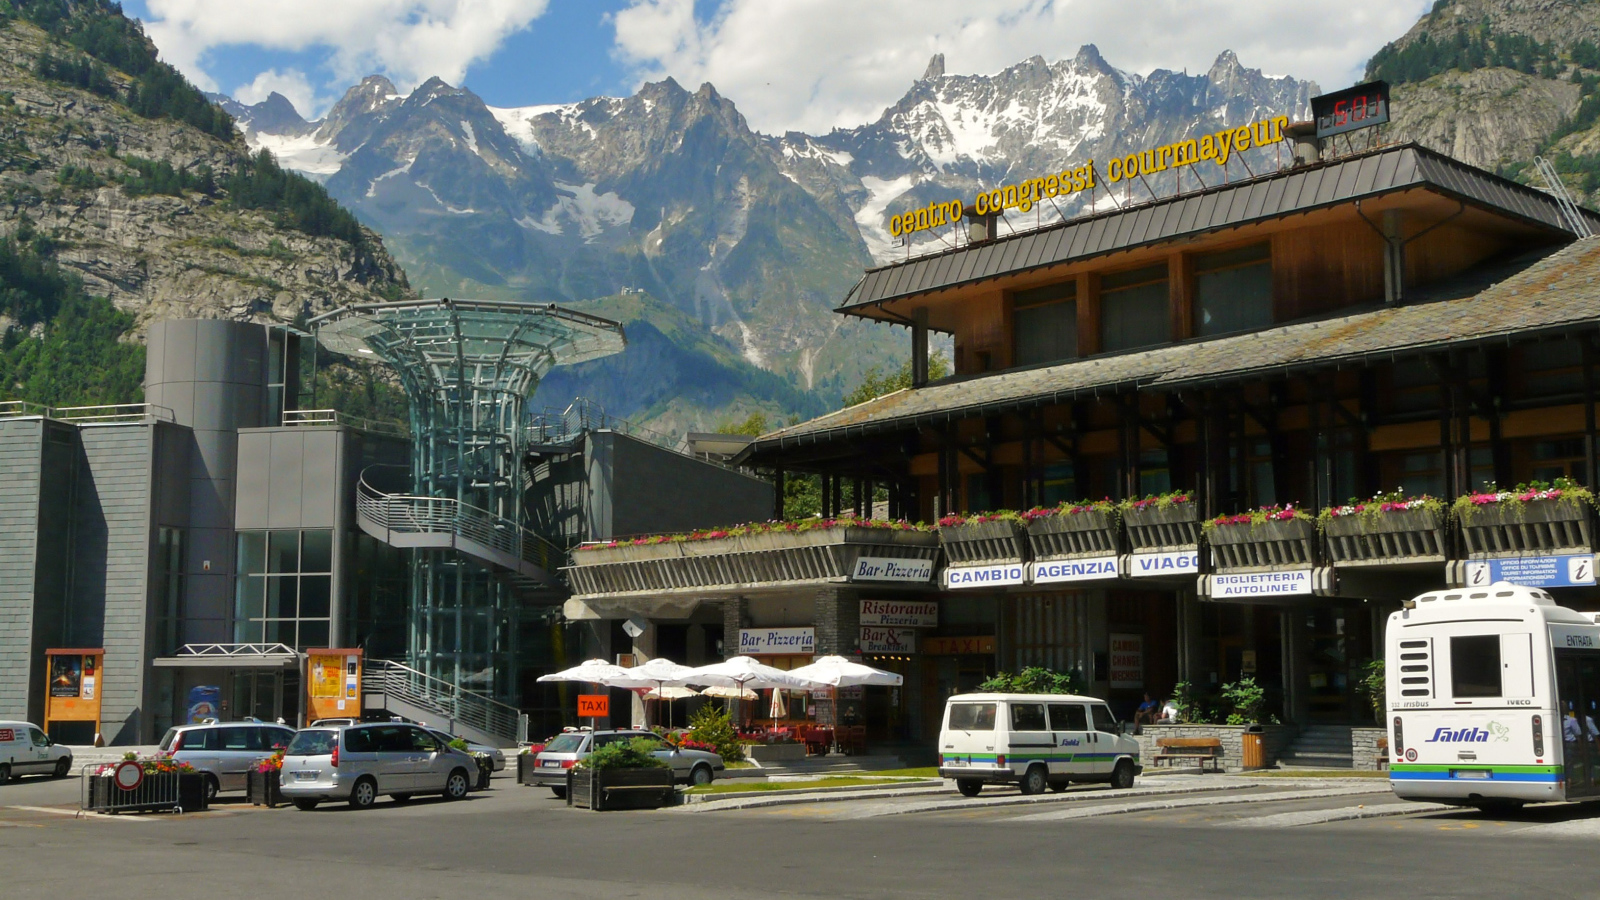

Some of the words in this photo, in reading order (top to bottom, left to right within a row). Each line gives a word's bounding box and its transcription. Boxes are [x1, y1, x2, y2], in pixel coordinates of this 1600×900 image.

[890, 199, 964, 237] centro
[975, 160, 1096, 215] congressi
[1107, 115, 1289, 182] courmayeur
[858, 561, 881, 577] Bar
[884, 562, 931, 578] Pizzeria
[950, 568, 1021, 583] CAMBIO
[1036, 561, 1117, 579] AGENZIA
[1216, 571, 1305, 585] BIGLIETTERIA
[1224, 583, 1298, 595] AUTOLINEE
[862, 601, 936, 615] Ristorante
[880, 615, 919, 625] Pizzeria
[741, 632, 762, 646] Bar
[767, 631, 813, 646] Pizzeria
[862, 628, 886, 641] Bar
[886, 628, 902, 646] &
[1566, 635, 1593, 647] ENTRATA
[868, 641, 908, 652] Breakfast
[939, 639, 980, 654] TAXI
[1112, 640, 1140, 652] CAMBIO
[1112, 655, 1140, 667] CHANGE
[581, 701, 606, 711] TAXI
